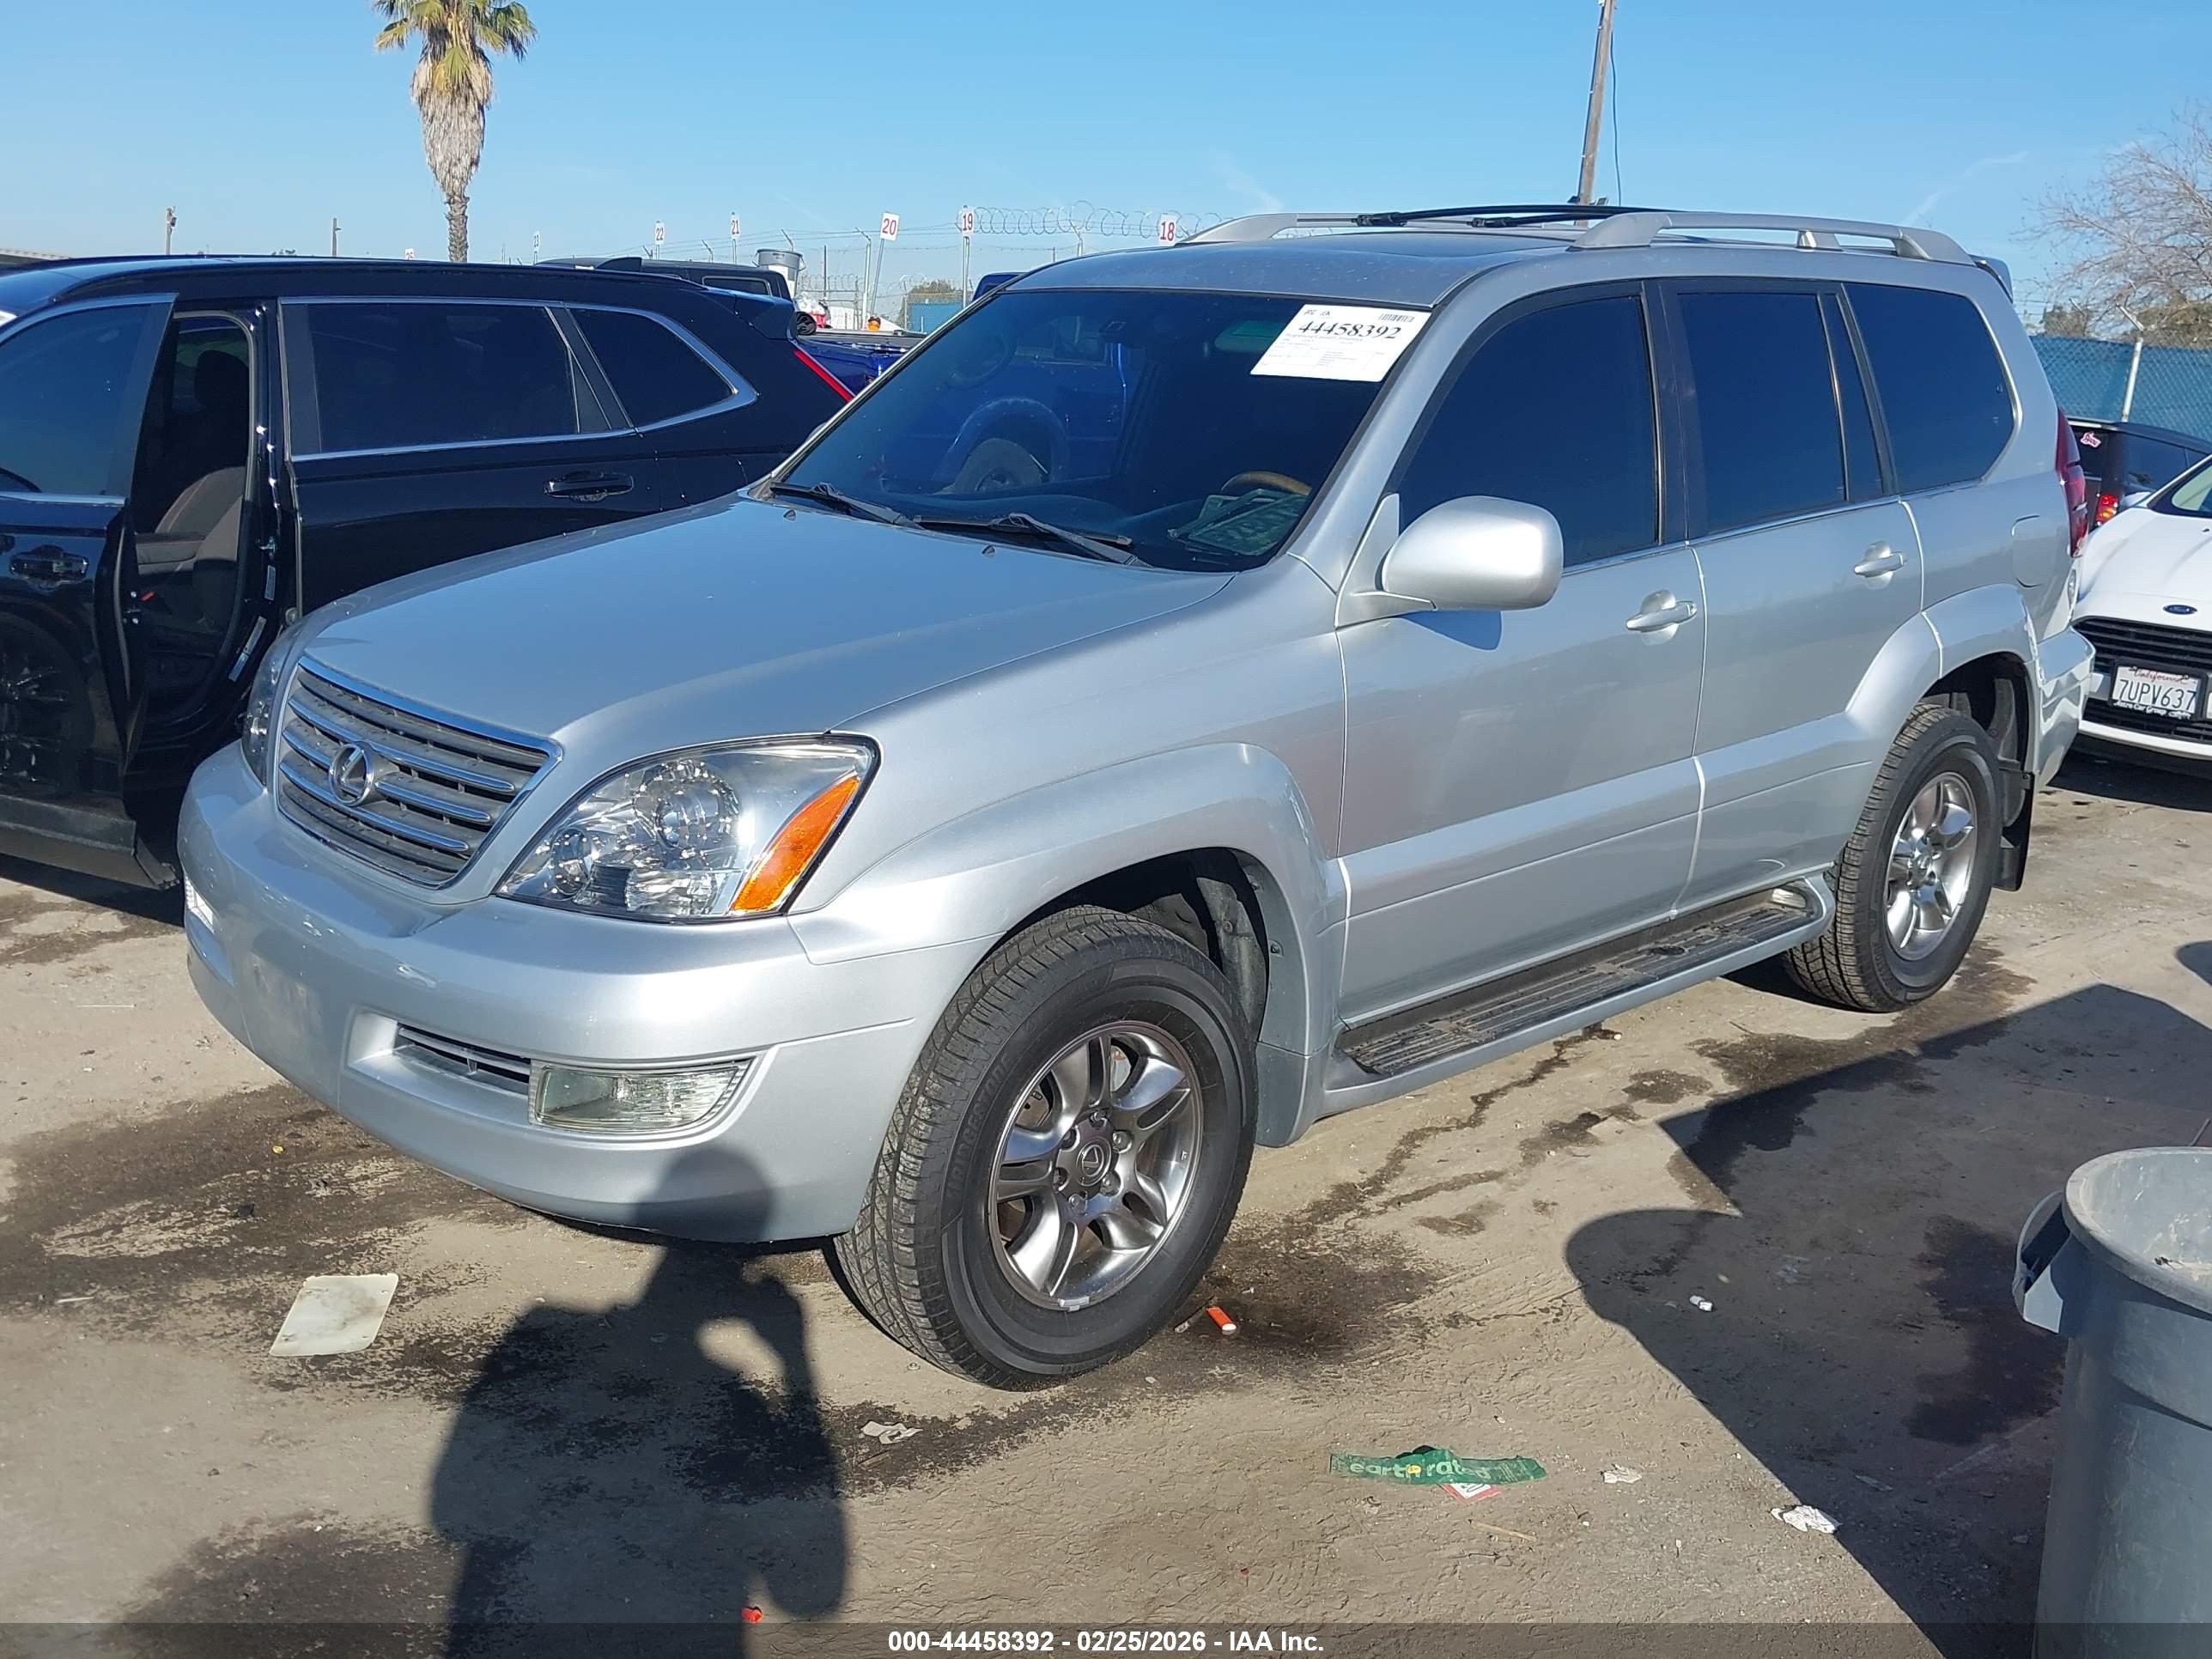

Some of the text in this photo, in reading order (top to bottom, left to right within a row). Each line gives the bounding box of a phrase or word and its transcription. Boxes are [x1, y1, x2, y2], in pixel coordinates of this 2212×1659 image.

[731, 220, 740, 234] 21
[882, 218, 897, 236] 20
[963, 213, 973, 231] 19
[1160, 221, 1176, 241] 18
[655, 227, 665, 241] 22
[1298, 320, 1402, 339] 44458392
[2119, 679, 2197, 711] 7UPV637
